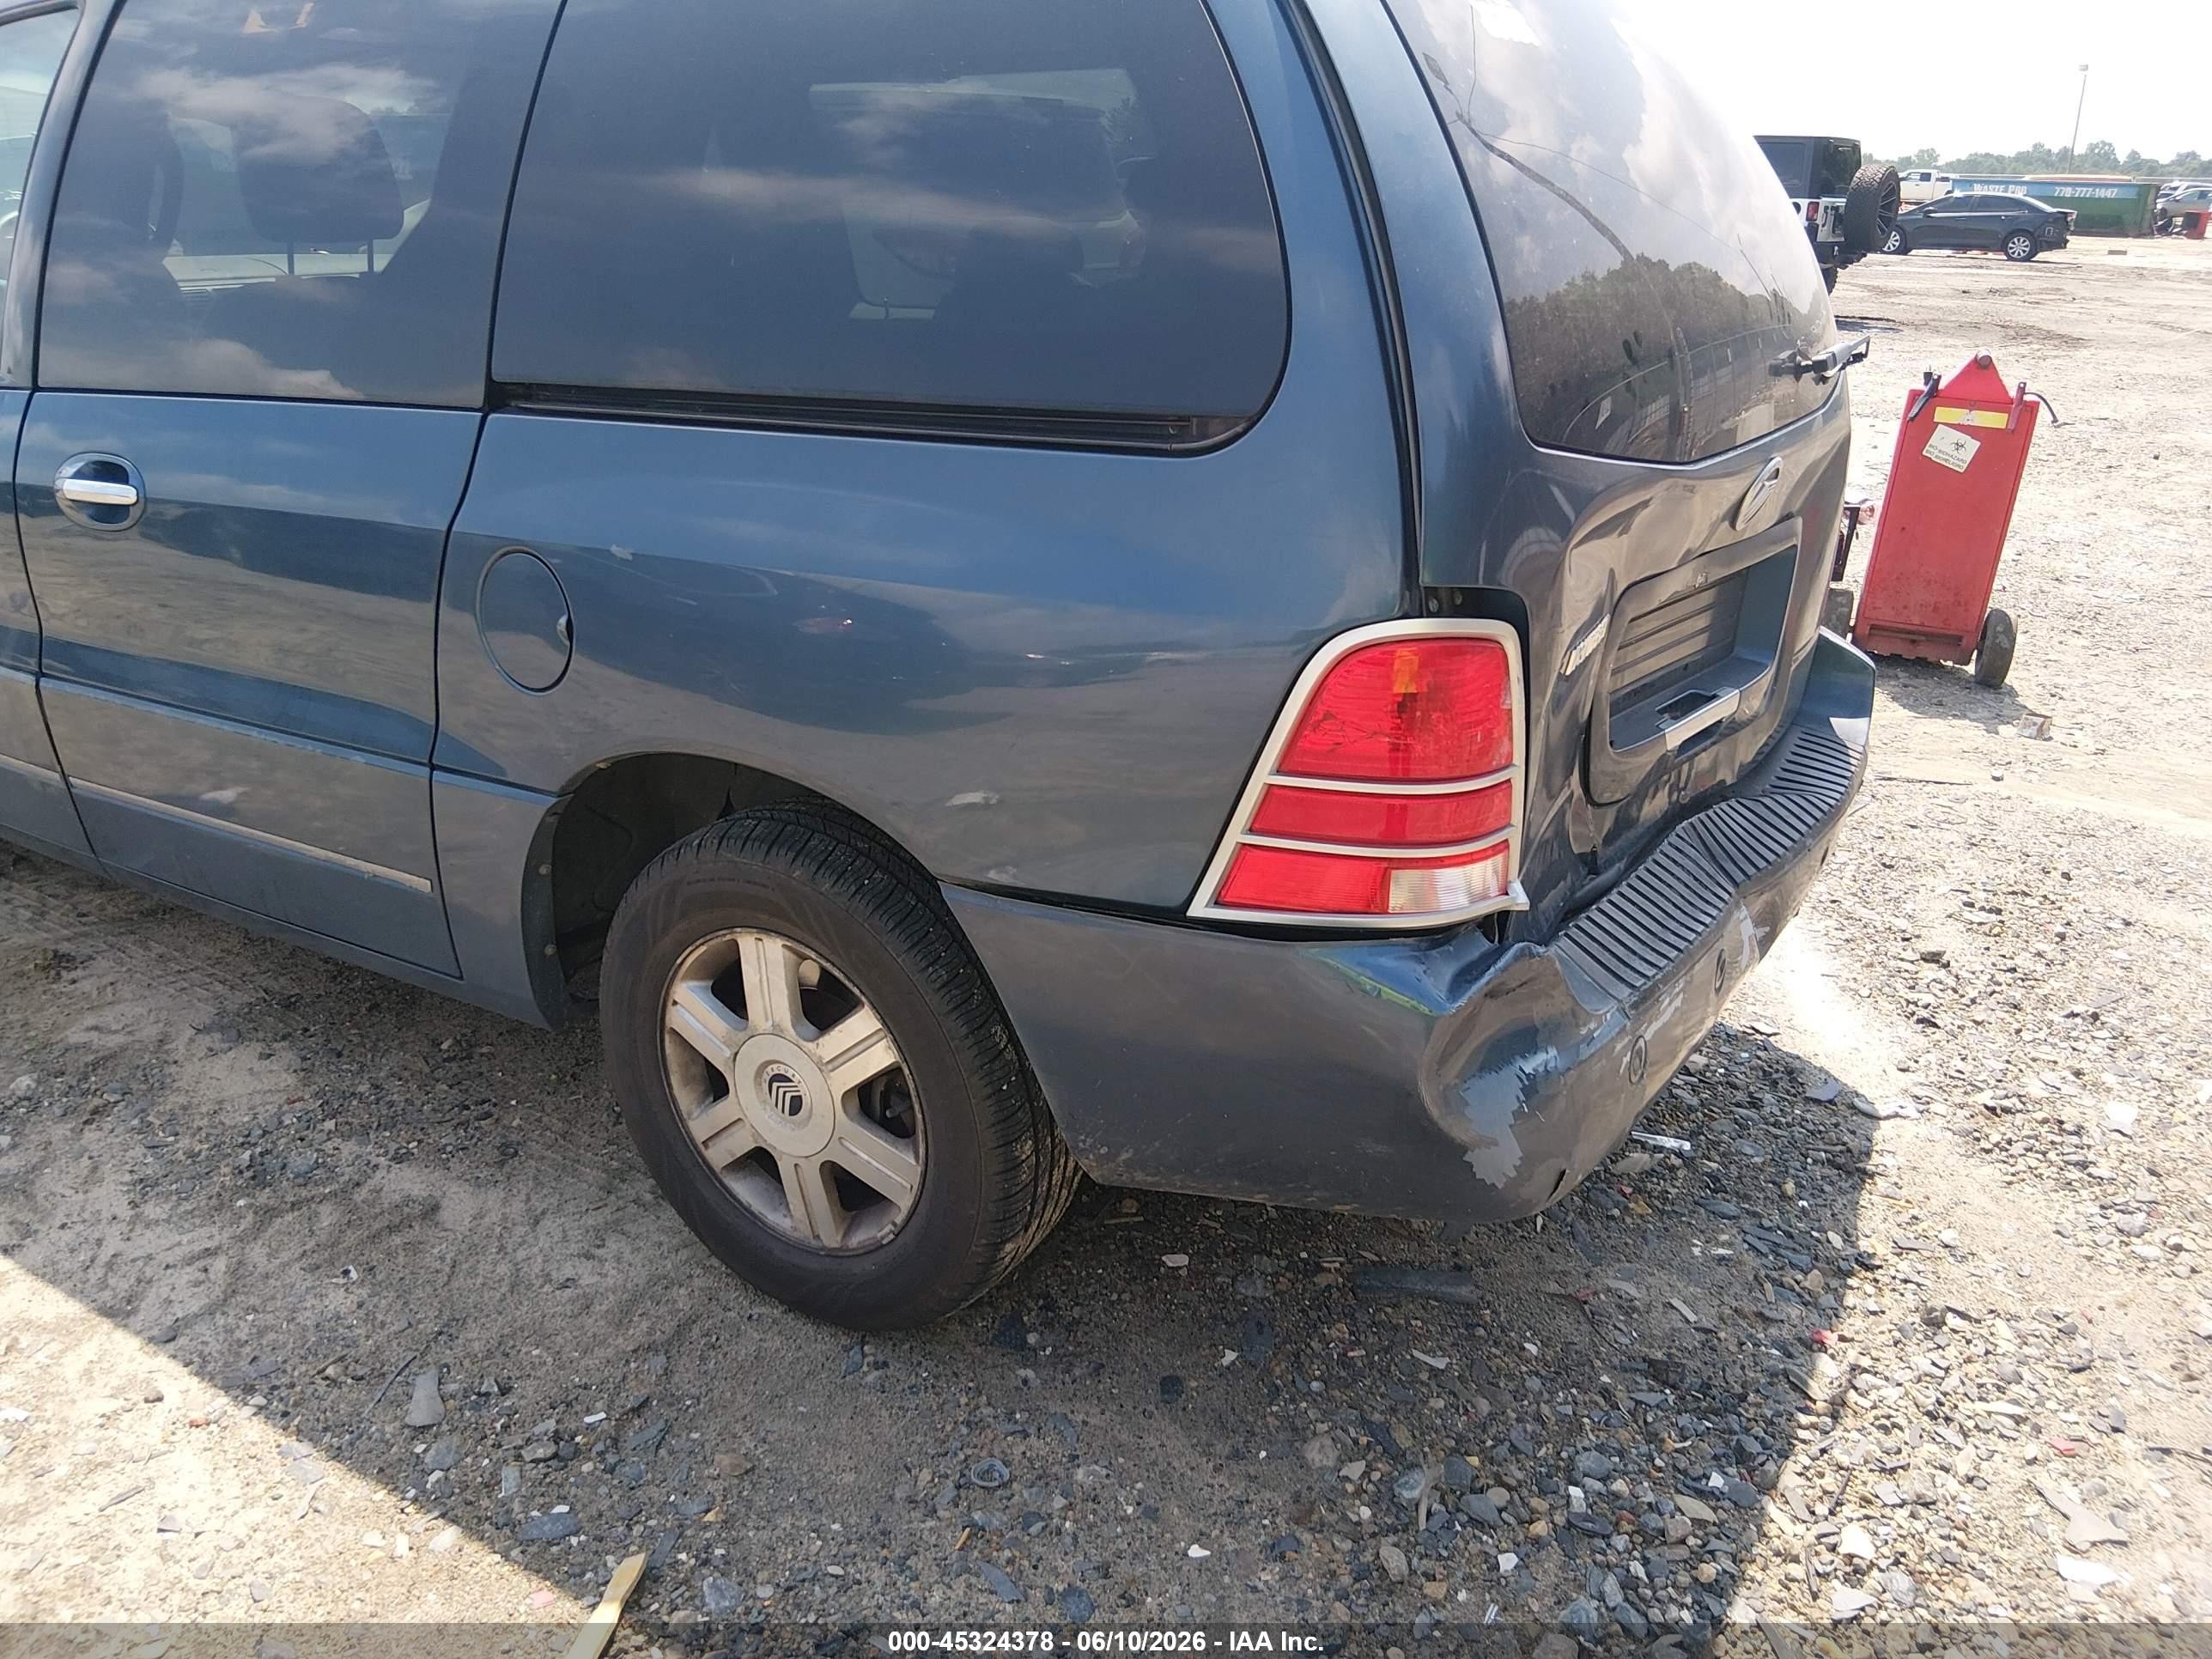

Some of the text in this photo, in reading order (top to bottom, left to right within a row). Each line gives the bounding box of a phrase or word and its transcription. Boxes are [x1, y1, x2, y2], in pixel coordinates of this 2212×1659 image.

[1974, 183, 2118, 198] WASTE PRO 770-777-1447
